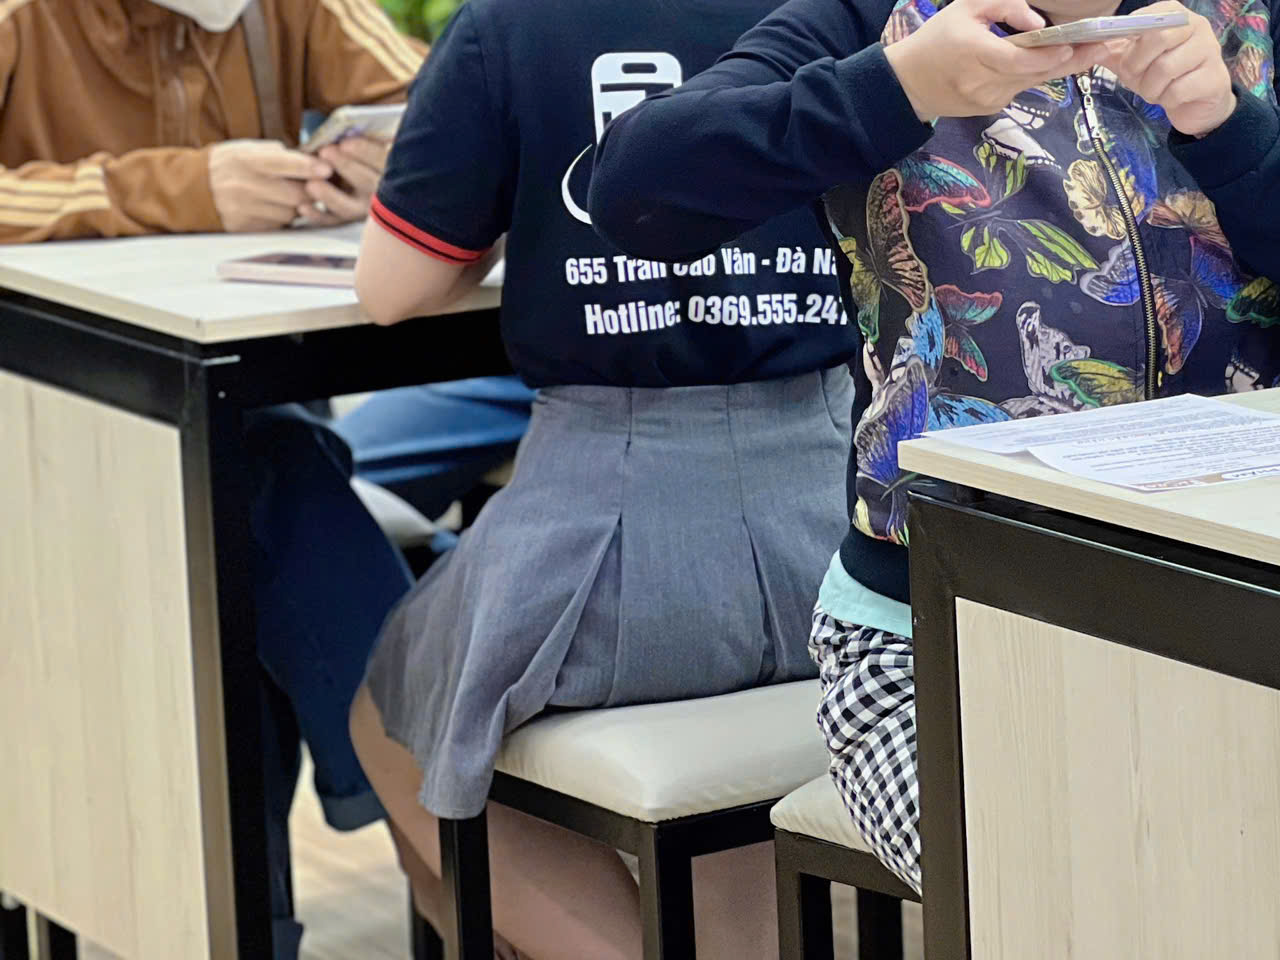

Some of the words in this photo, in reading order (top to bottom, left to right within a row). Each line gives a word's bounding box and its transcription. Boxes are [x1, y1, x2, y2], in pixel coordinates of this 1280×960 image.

[565, 257, 608, 286] 655
[720, 246, 756, 275] Vân
[775, 246, 807, 274] Đà
[584, 300, 681, 335] Hotline:
